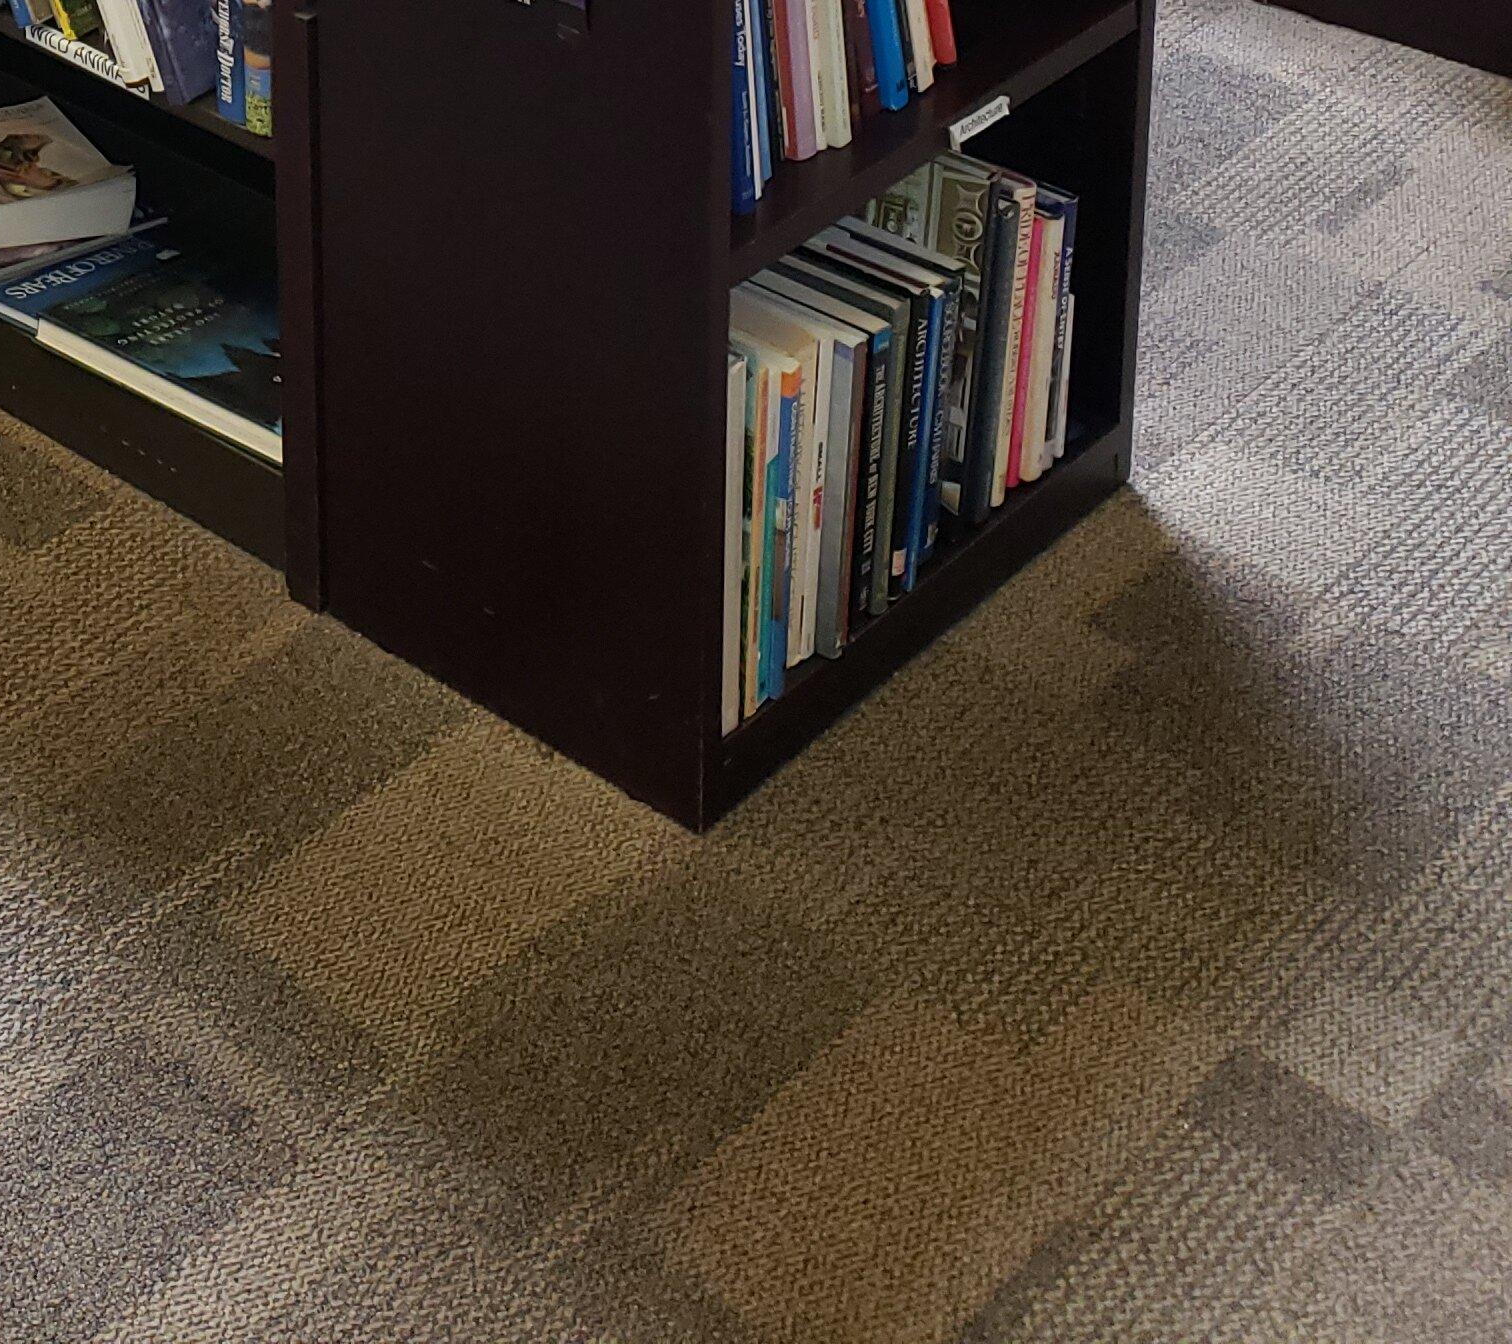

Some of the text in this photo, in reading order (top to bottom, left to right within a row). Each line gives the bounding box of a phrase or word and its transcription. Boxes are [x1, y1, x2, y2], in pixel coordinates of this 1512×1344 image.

[29, 25, 126, 82] WILD ANIMA
[959, 102, 1004, 137] Architecture
